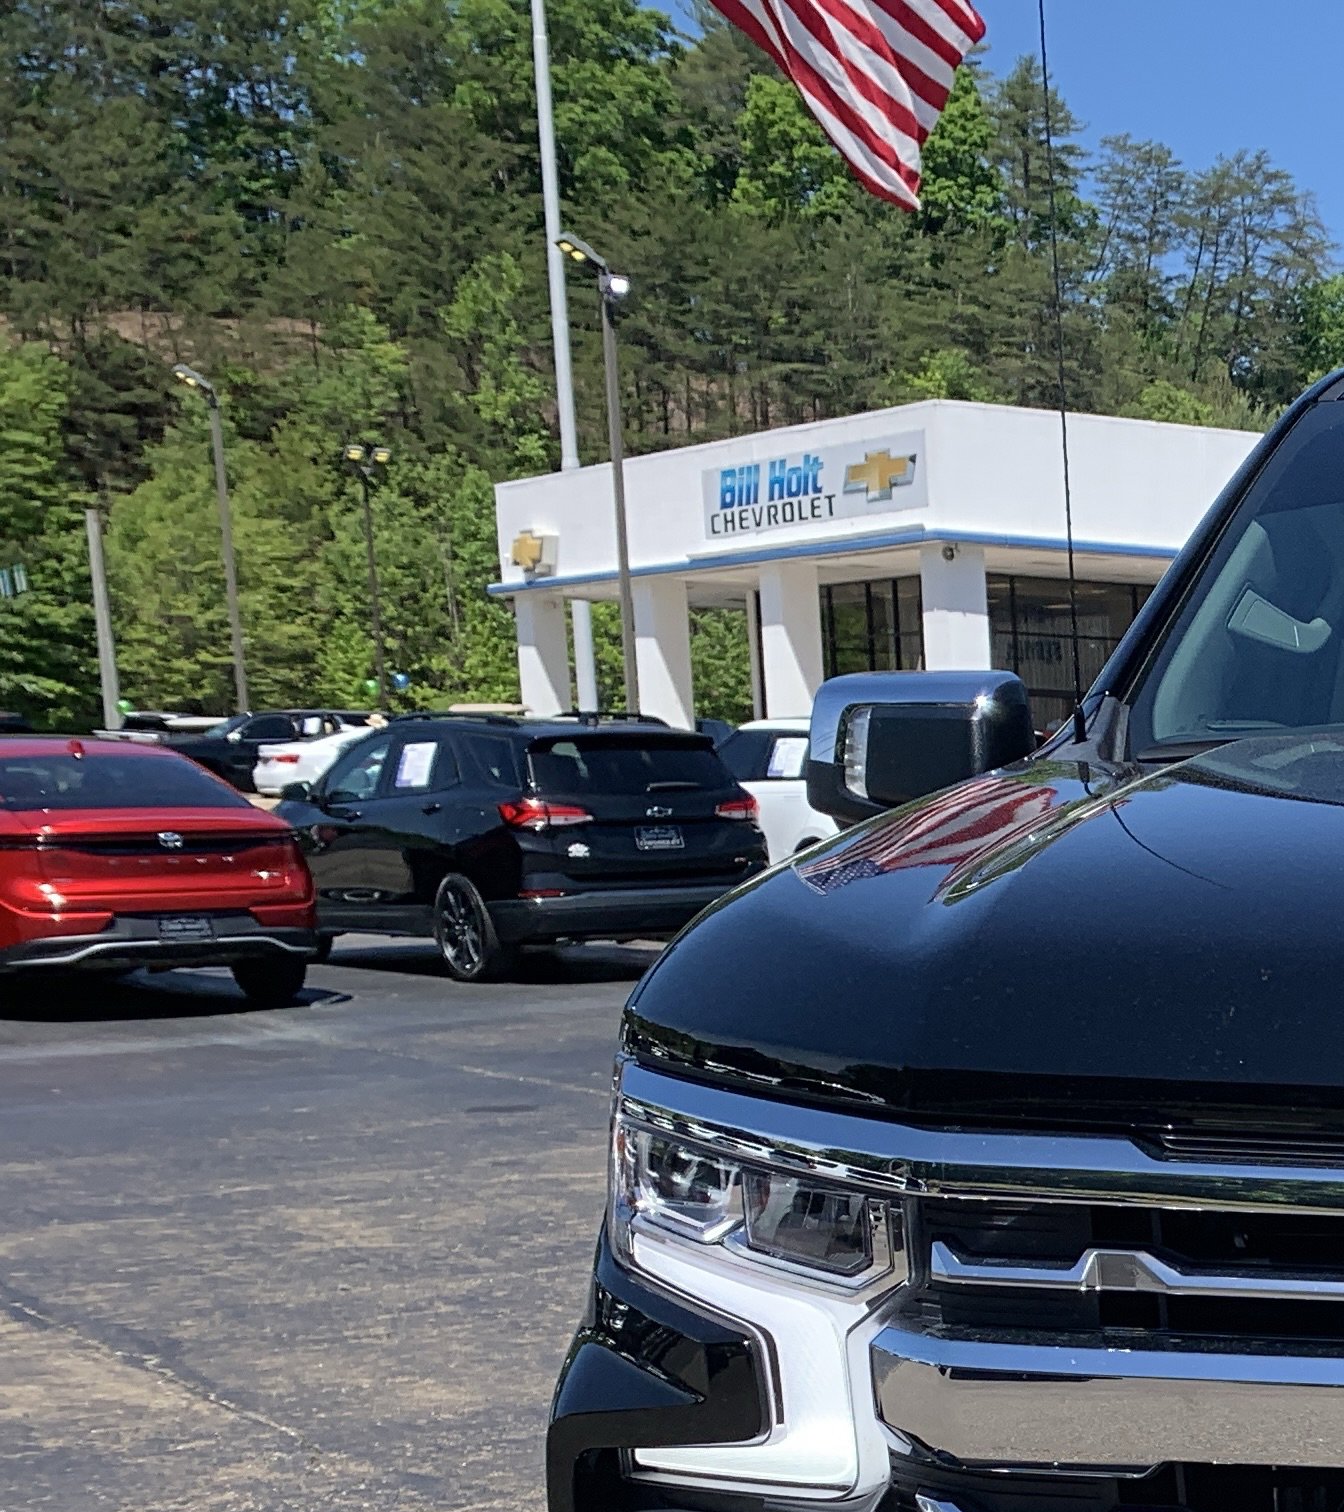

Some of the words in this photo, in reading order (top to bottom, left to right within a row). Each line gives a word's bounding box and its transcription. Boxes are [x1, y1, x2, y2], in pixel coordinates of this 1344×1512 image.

[719, 463, 760, 510] Bill
[768, 453, 824, 502] Holt
[710, 494, 836, 535] CHEVROLET
